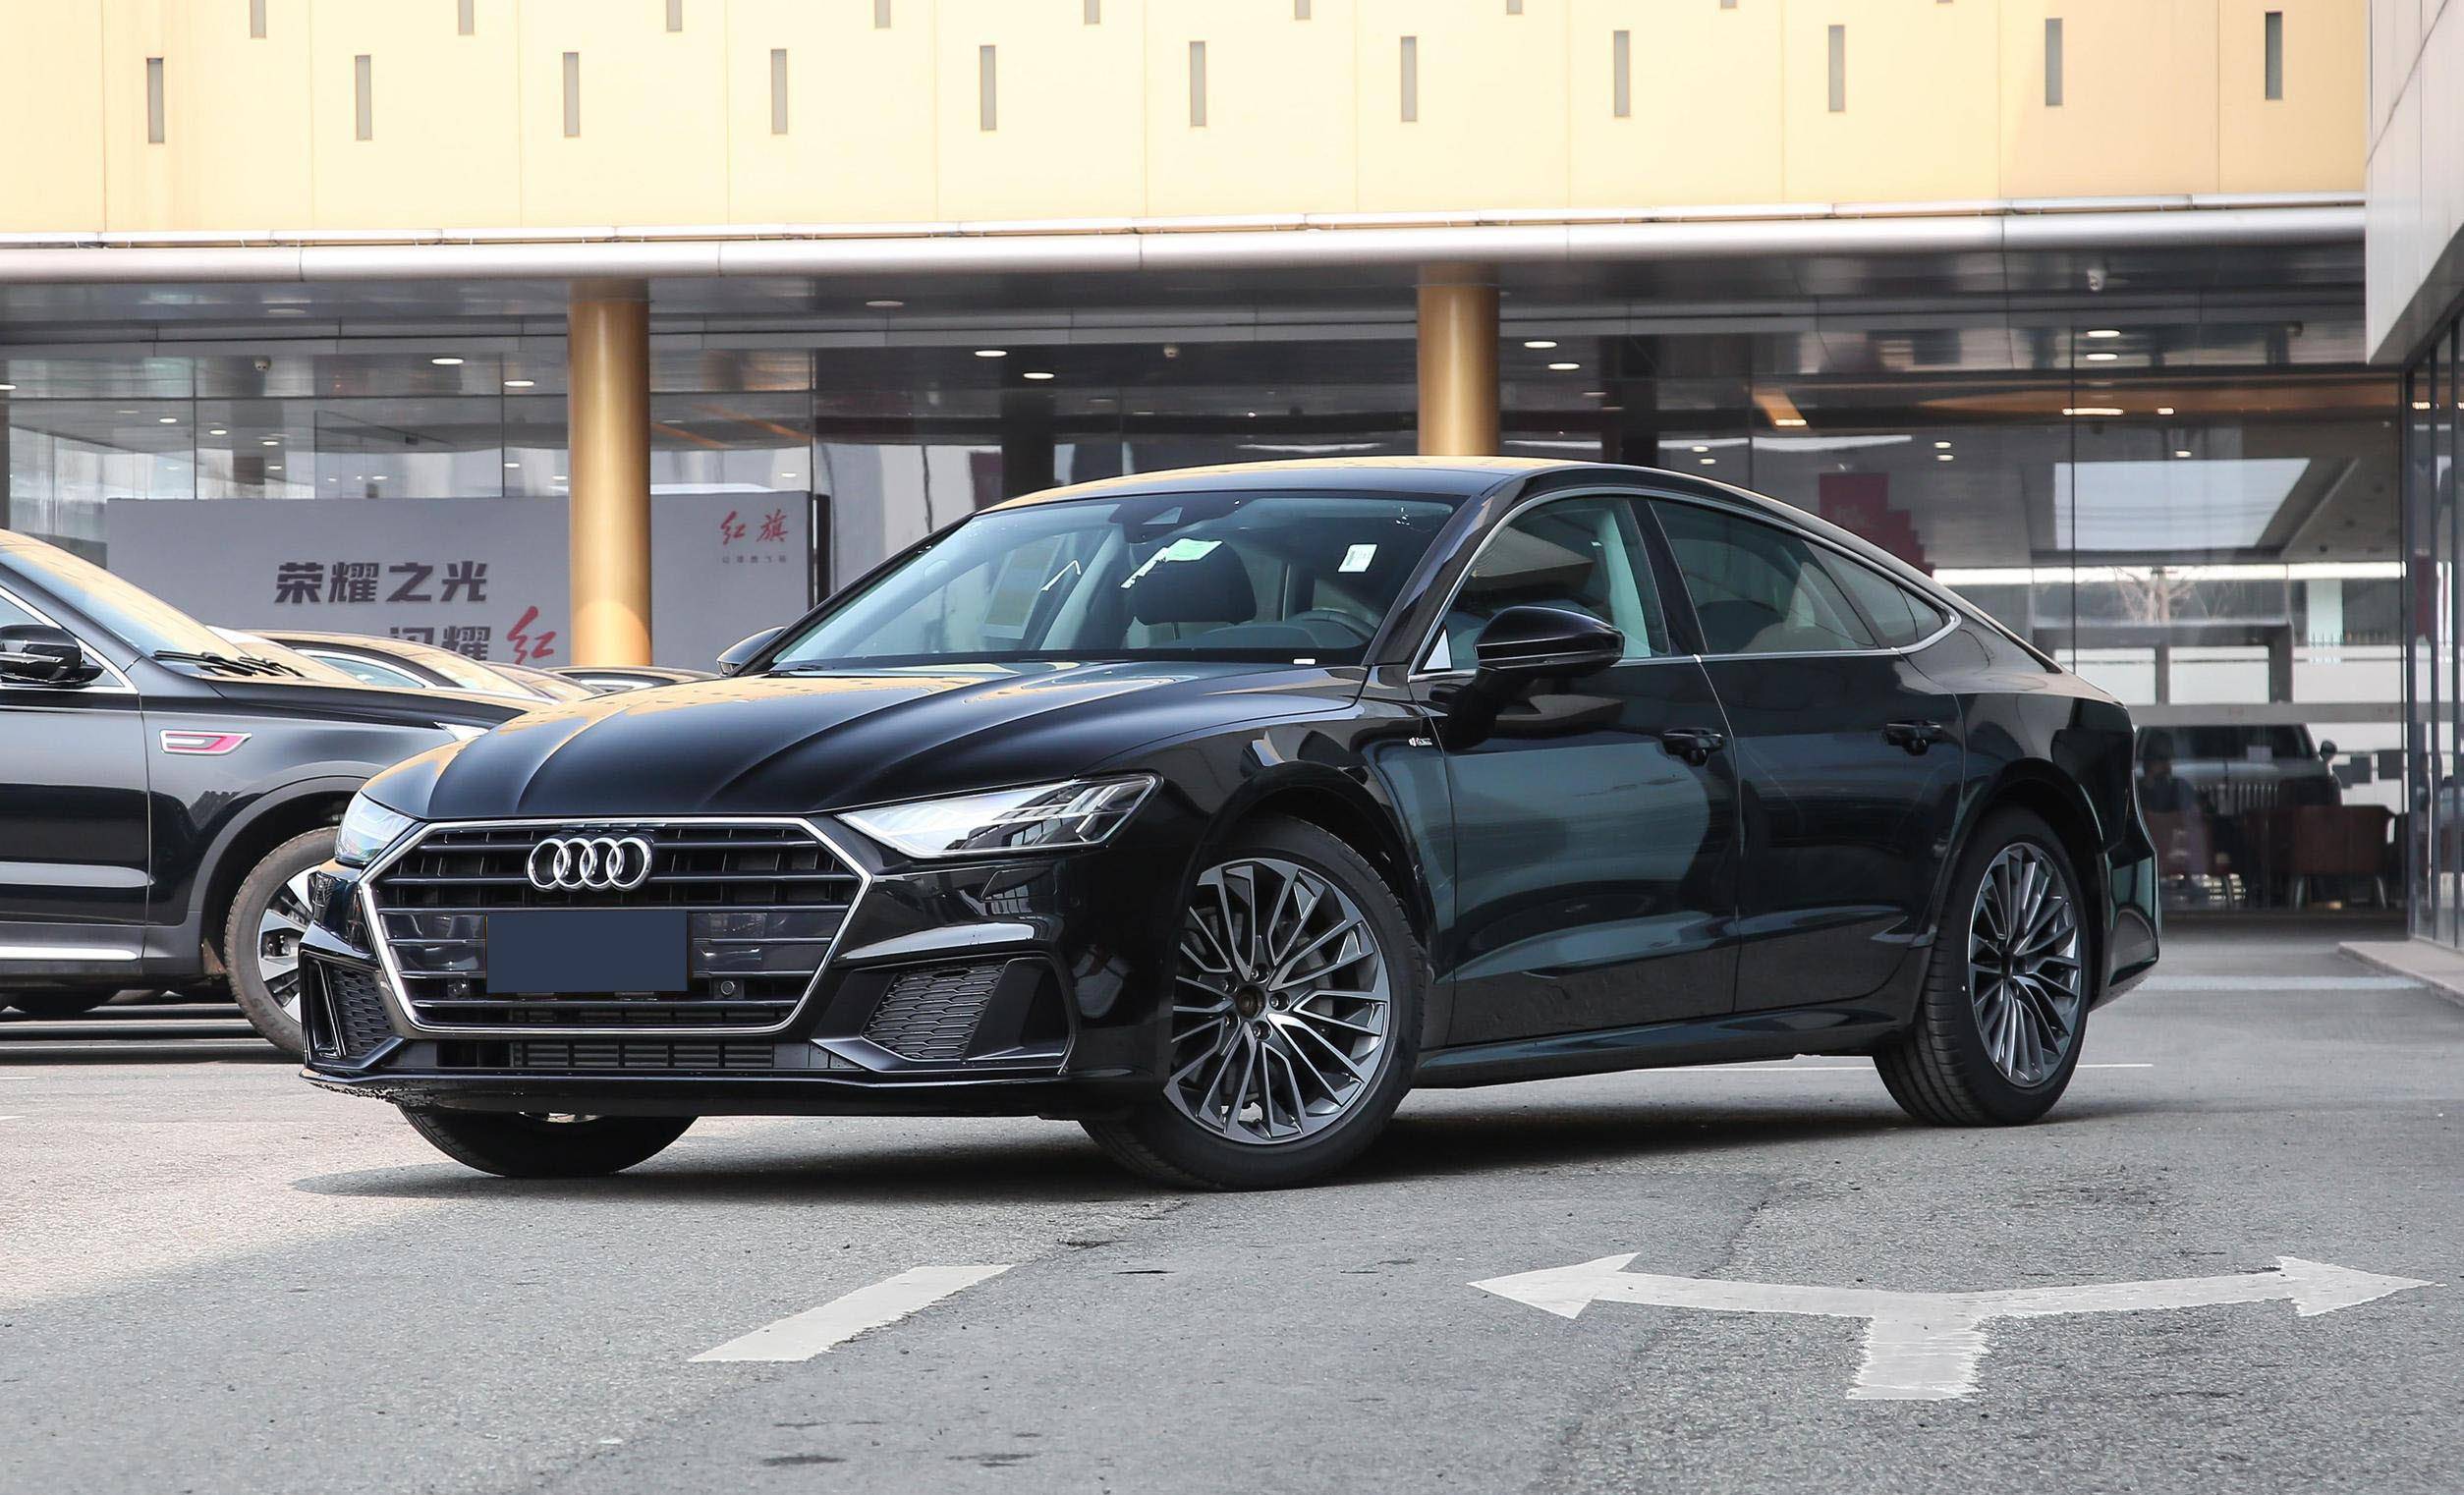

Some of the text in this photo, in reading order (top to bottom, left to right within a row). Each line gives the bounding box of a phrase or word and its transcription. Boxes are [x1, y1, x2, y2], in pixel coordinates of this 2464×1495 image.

[720, 510, 788, 544] 红旗
[274, 561, 487, 603] 荣耀之光
